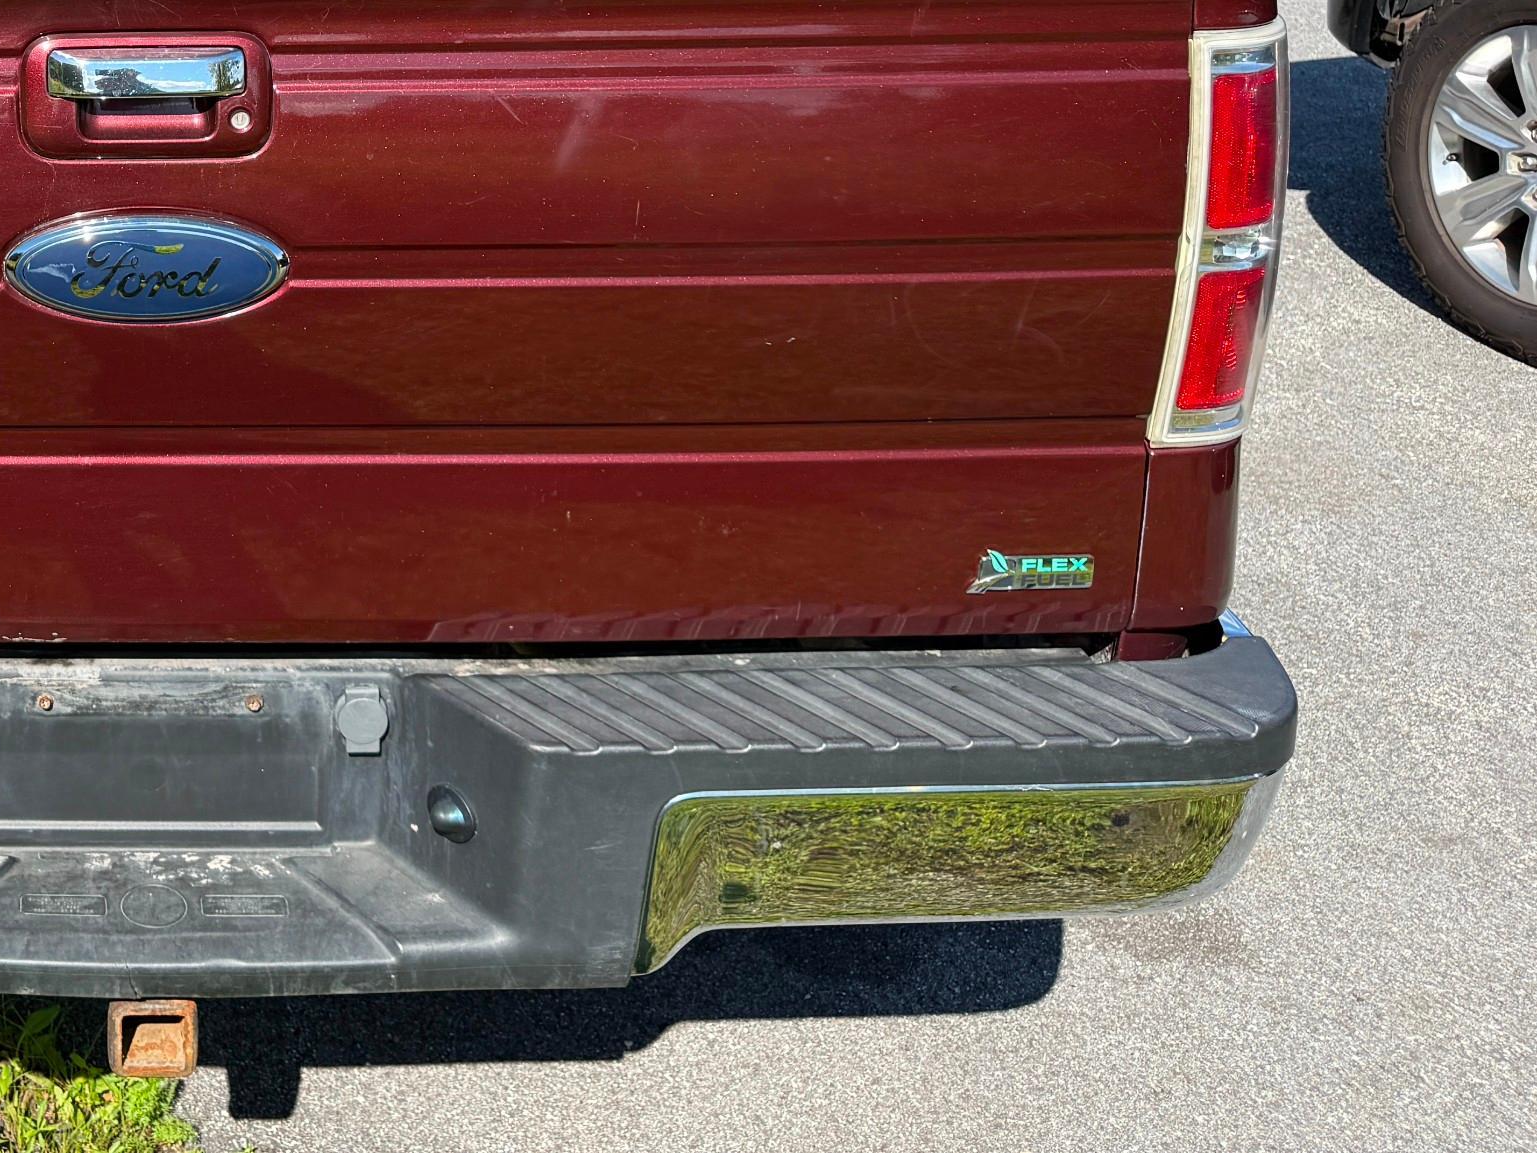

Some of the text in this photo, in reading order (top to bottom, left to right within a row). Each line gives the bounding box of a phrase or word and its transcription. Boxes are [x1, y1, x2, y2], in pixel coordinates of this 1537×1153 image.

[70, 240, 222, 299] Ford
[1021, 557, 1089, 573] FLEX
[1021, 574, 1087, 587] FUEL
